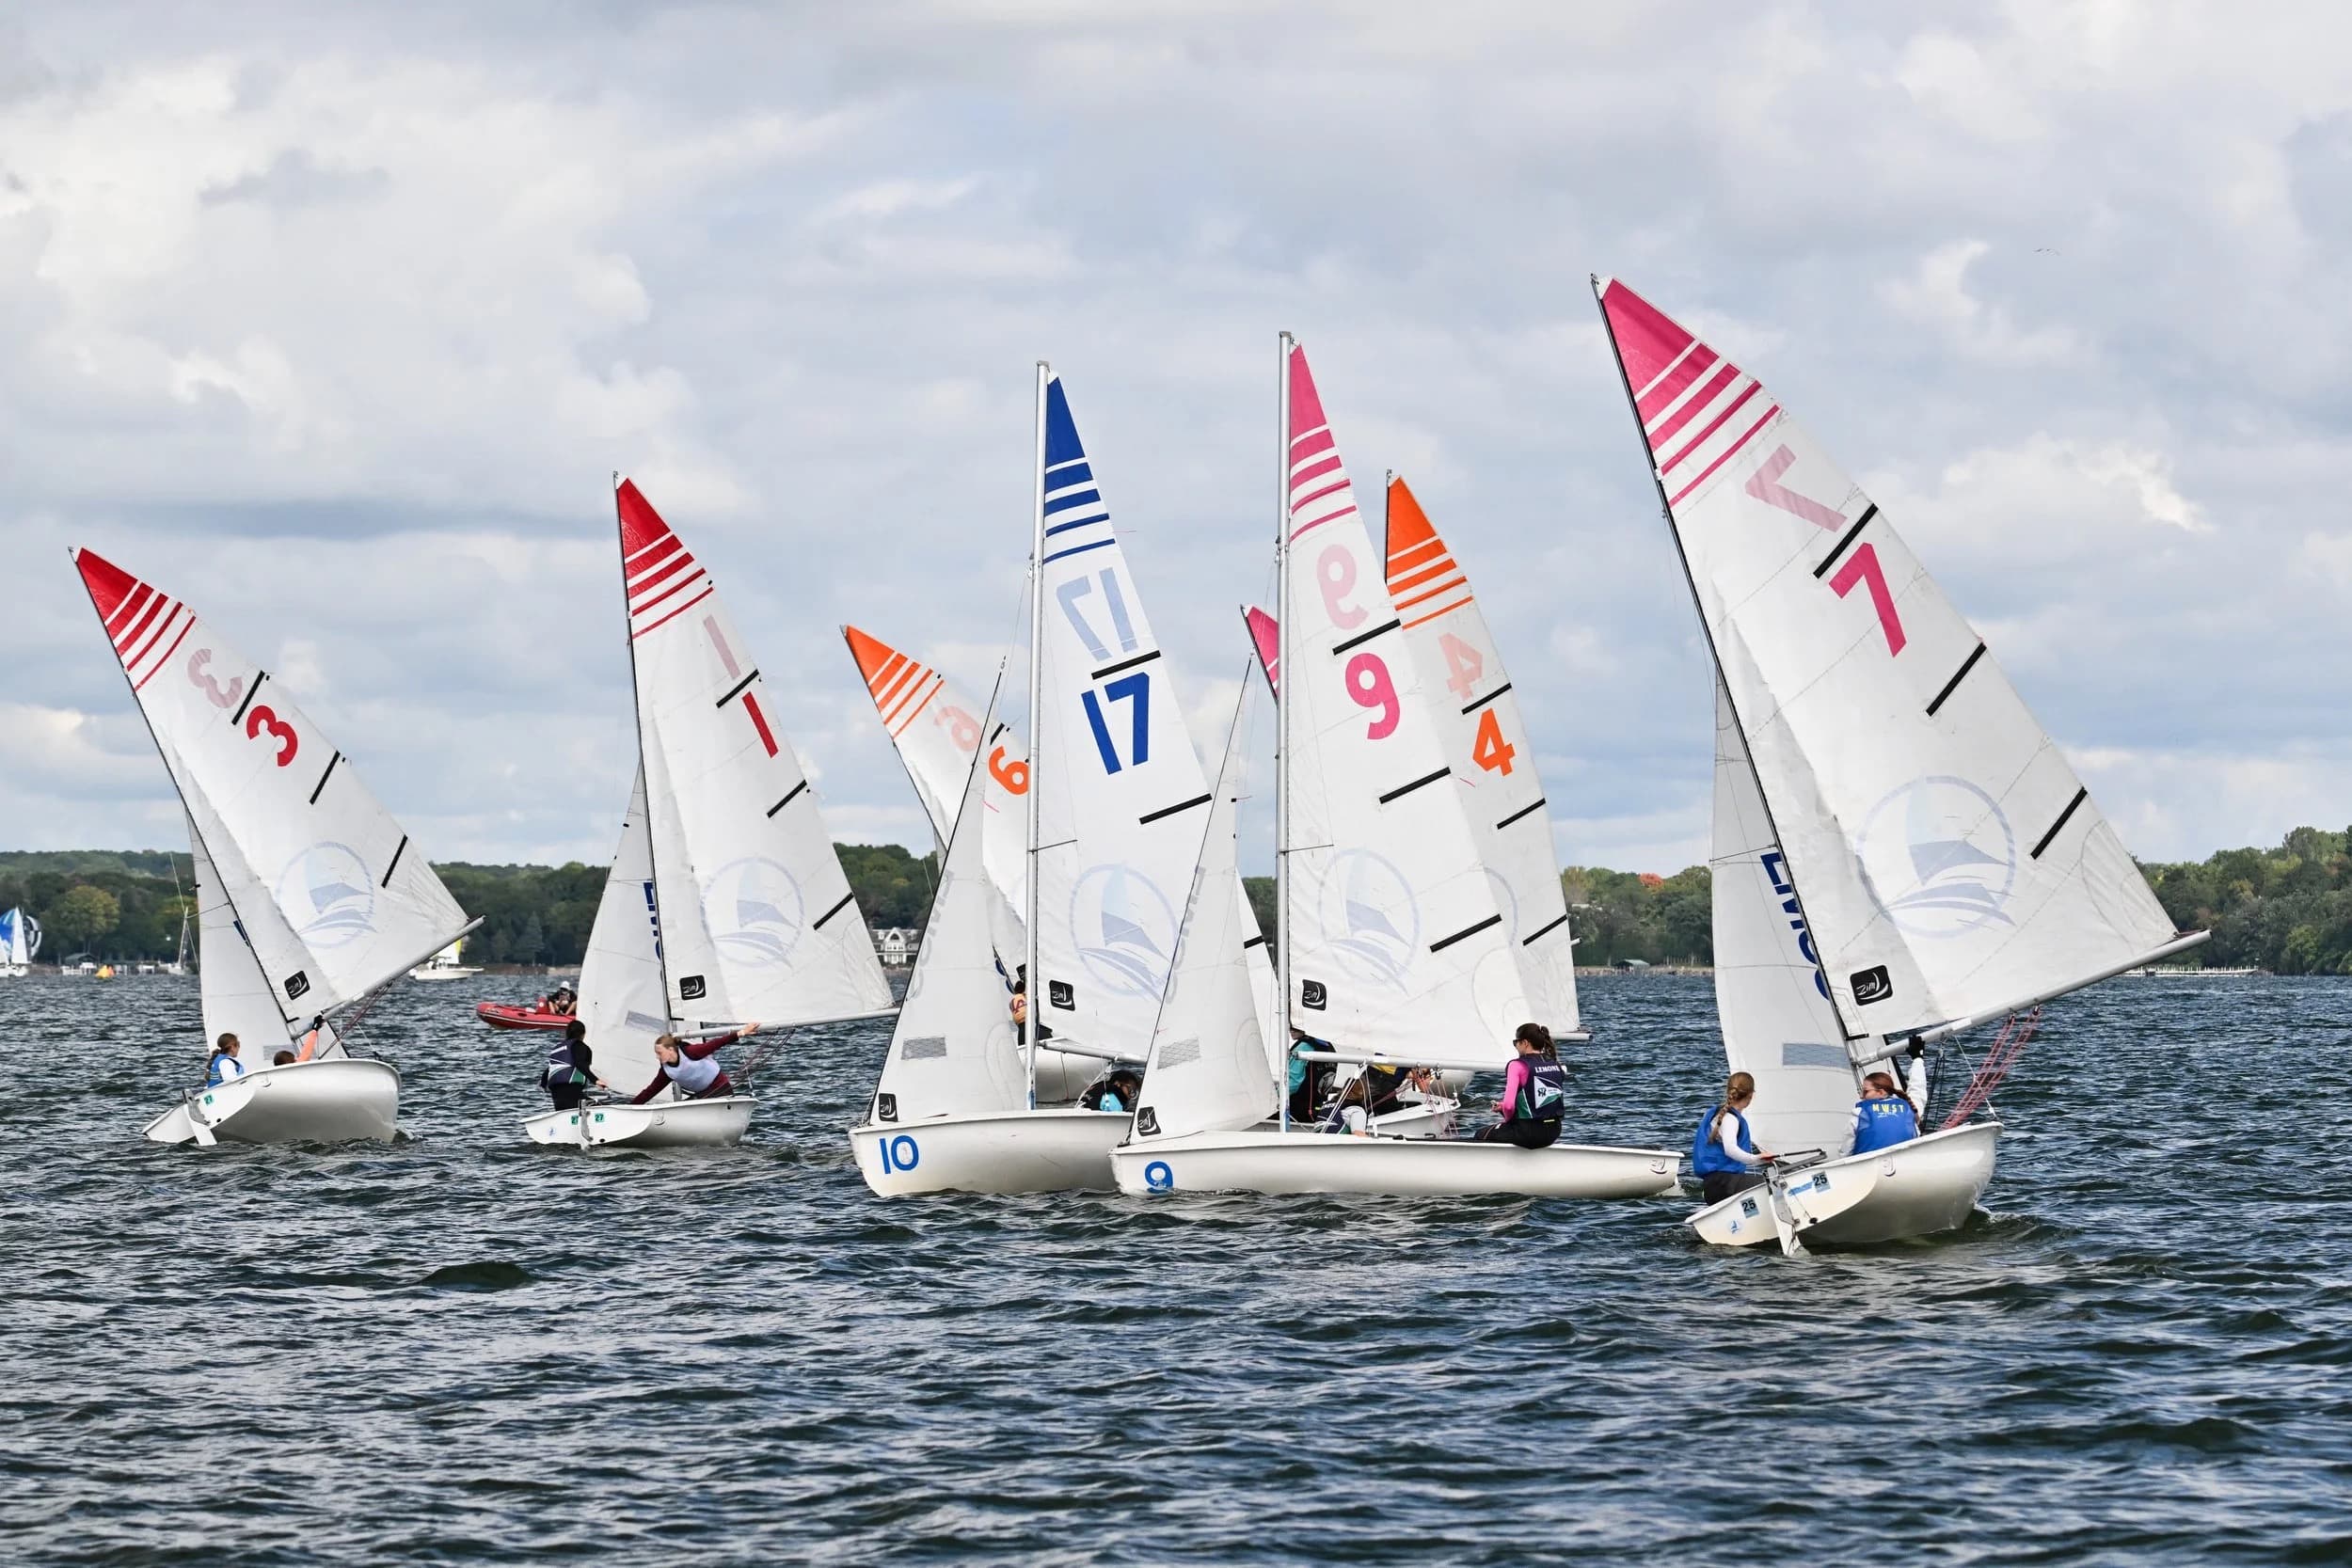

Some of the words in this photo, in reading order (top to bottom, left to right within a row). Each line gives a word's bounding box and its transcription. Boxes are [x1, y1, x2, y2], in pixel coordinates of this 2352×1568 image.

[1829, 542, 1907, 657] 7
[741, 691, 779, 758] 1
[1081, 672, 1150, 775] 17
[1345, 653, 1400, 739] 9
[246, 705, 298, 767] 3
[1472, 707, 1516, 777] 4
[989, 745, 1029, 796] 6
[879, 1134, 919, 1175] 10
[1144, 1161, 1173, 1195] 9
[1812, 1174, 1828, 1186] 25
[1741, 1199, 1756, 1212] 25
